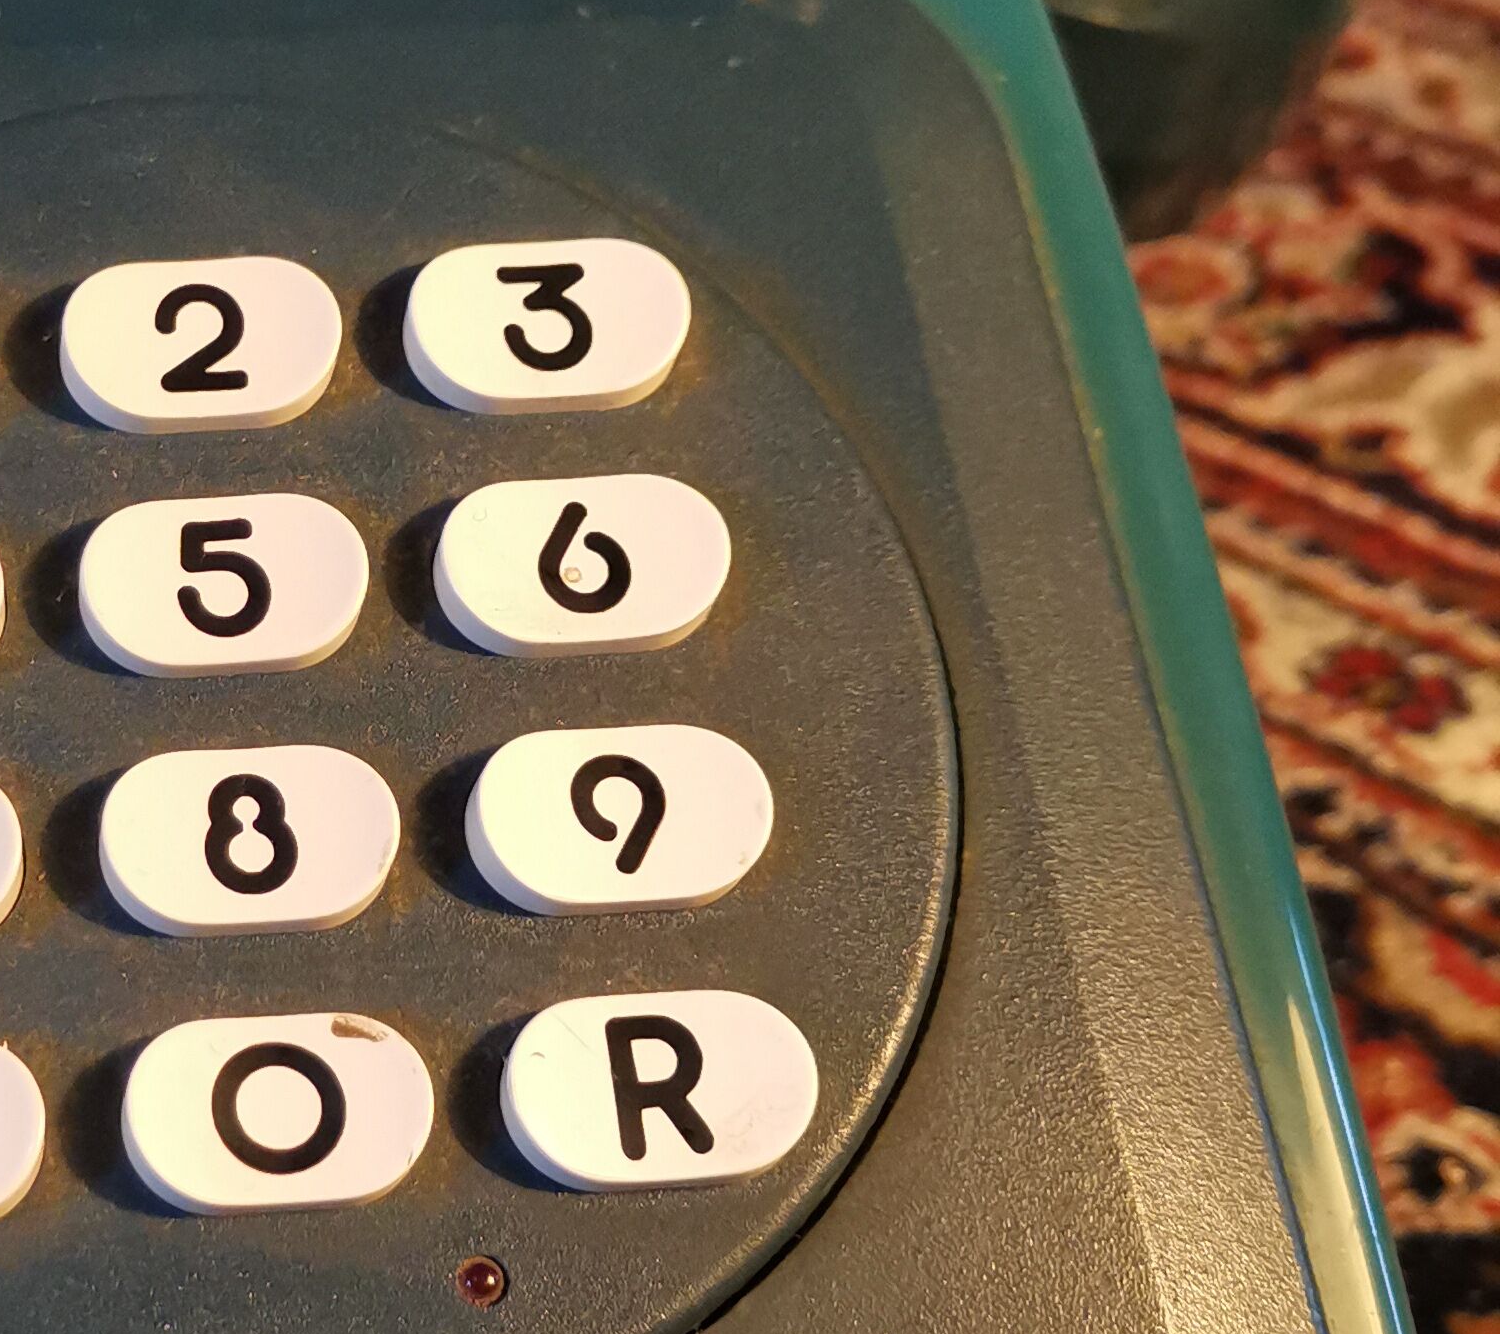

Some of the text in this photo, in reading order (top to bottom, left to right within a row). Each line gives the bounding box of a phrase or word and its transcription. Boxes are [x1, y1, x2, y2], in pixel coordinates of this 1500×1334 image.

[154, 284, 248, 392] 2
[497, 264, 592, 371] 3
[177, 519, 271, 638] 5
[539, 502, 630, 613] 6
[205, 773, 298, 896] 8
[571, 754, 666, 874] 9
[605, 1016, 713, 1160] R
